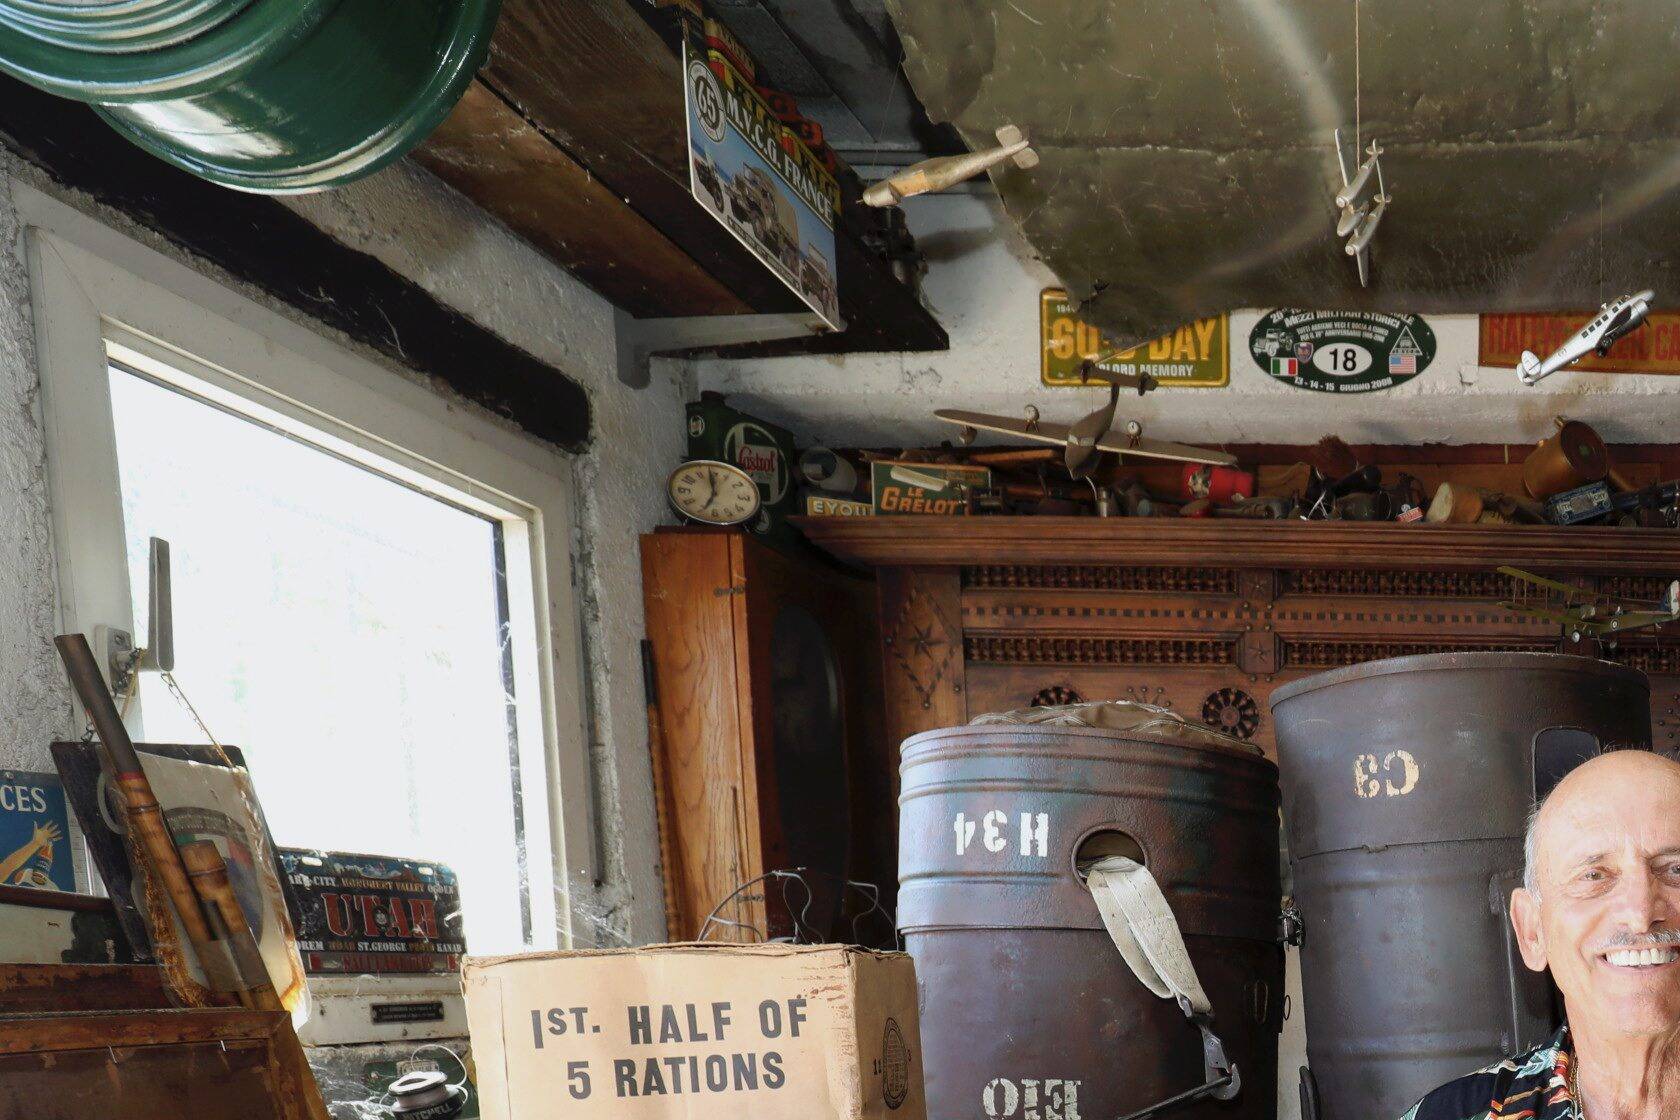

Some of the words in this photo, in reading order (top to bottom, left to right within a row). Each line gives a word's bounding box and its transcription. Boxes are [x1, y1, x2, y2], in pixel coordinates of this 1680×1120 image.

[697, 76, 716, 125] 65
[784, 152, 833, 223] FRANCE
[1139, 363, 1194, 377] MEMORY
[1329, 348, 1357, 372] 18
[738, 446, 776, 474] Castrol
[907, 487, 924, 498] LE
[0, 785, 48, 813] CES
[320, 892, 439, 939] UTAH
[357, 941, 407, 952] ST.GEORGE
[627, 1000, 732, 1046] HALF
[758, 996, 809, 1039] OF
[566, 1060, 592, 1100] 5
[613, 1051, 787, 1098] RATIONS
